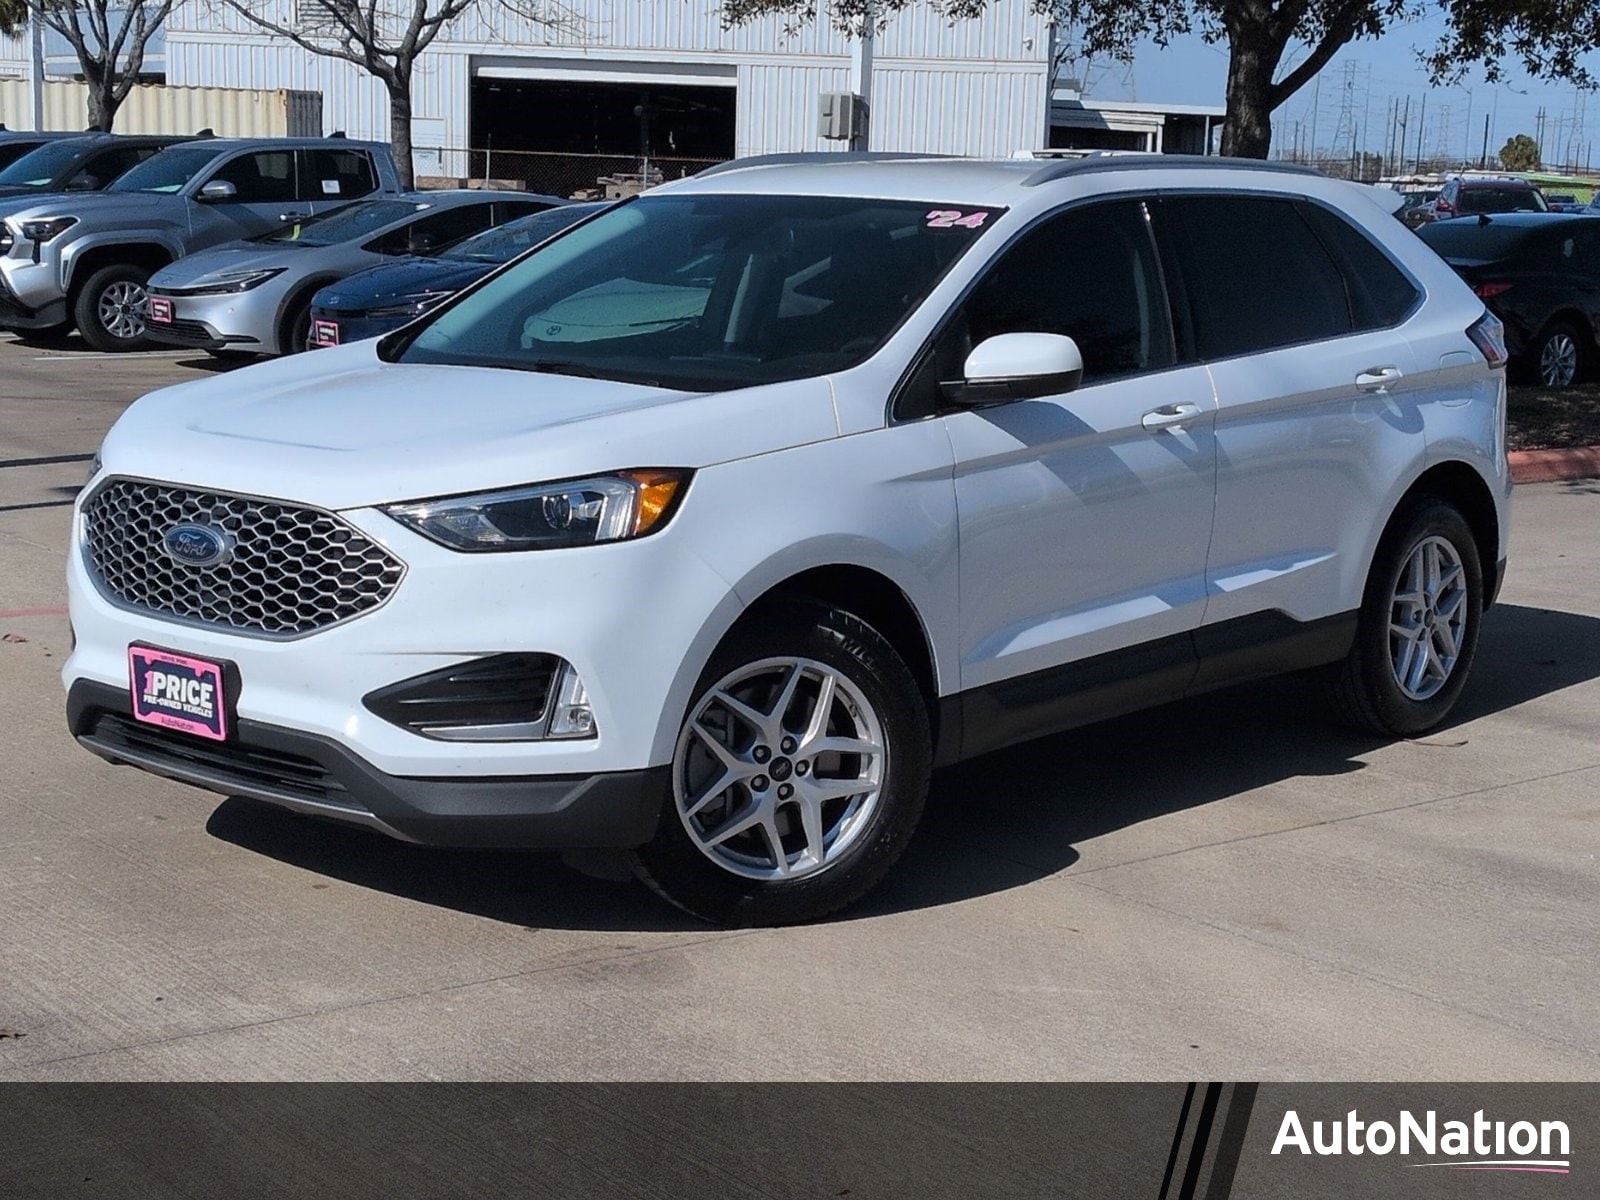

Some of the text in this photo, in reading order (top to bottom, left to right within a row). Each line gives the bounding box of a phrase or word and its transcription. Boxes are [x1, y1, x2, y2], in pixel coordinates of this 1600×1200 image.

[175, 532, 209, 556] Ford
[144, 670, 213, 709] 1PRICE
[183, 702, 213, 718] VEHICLES
